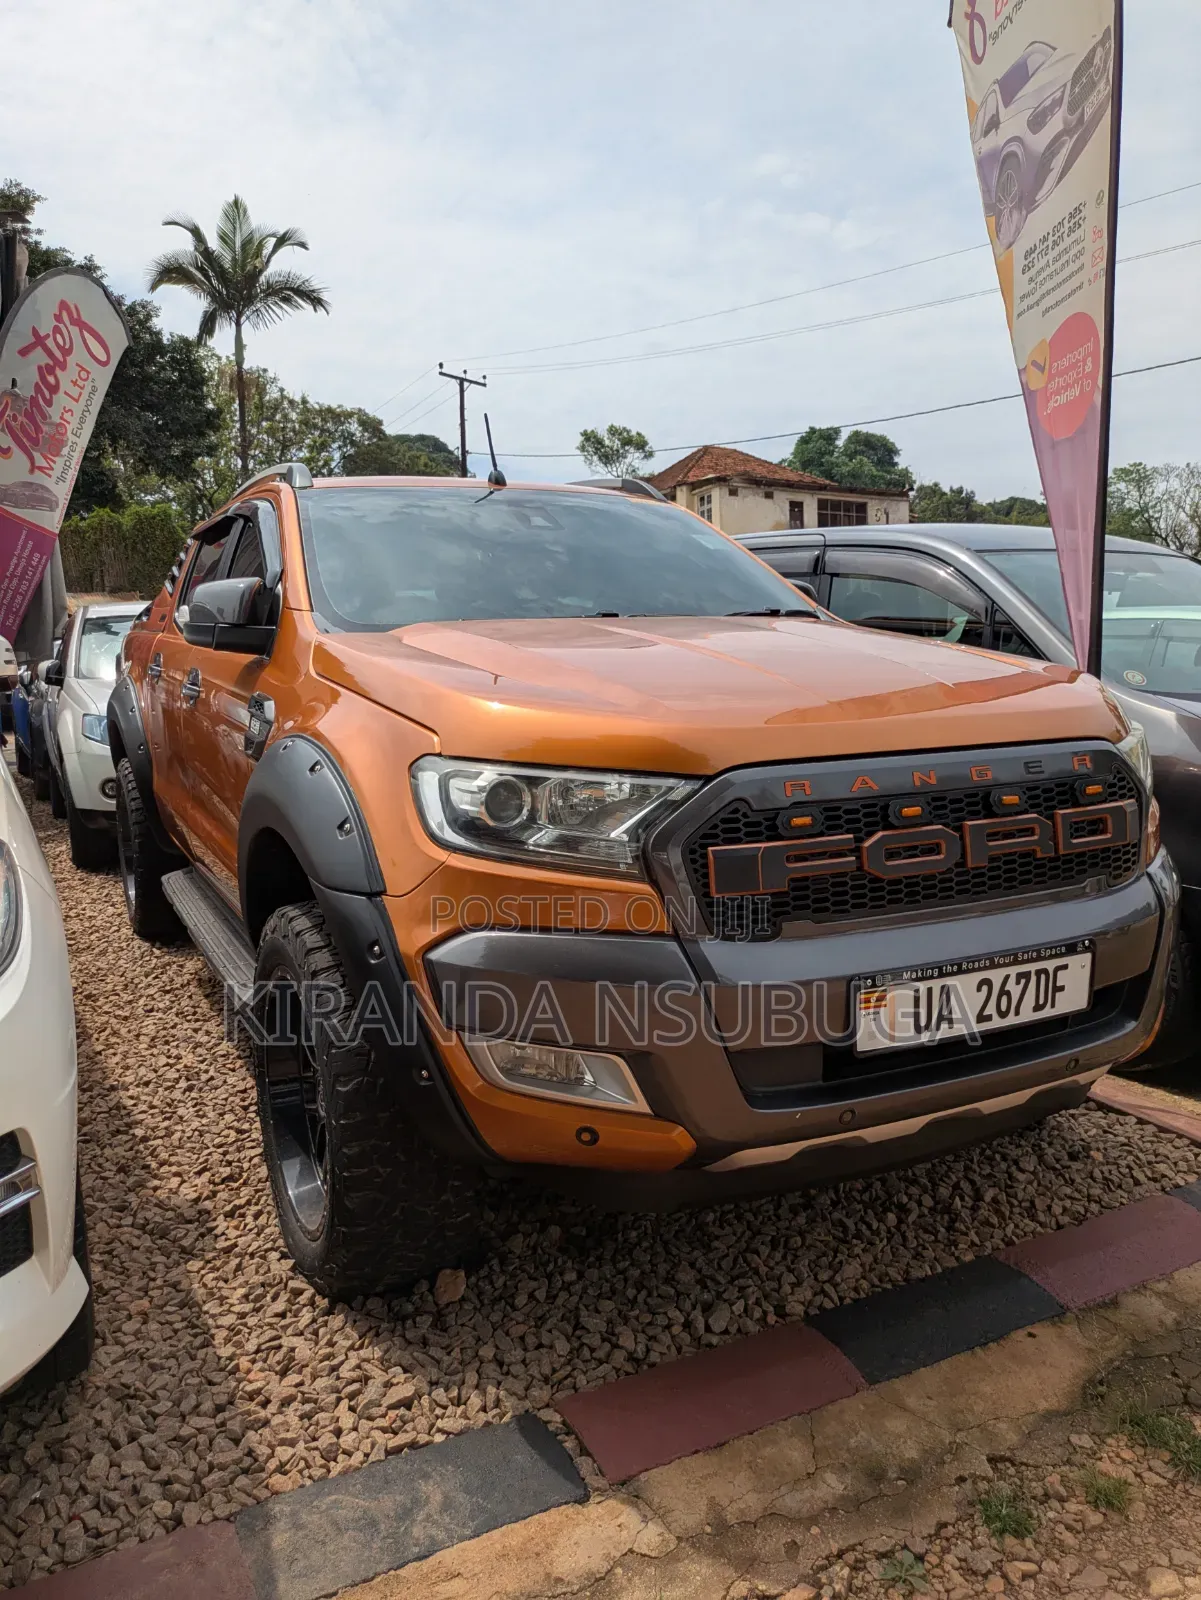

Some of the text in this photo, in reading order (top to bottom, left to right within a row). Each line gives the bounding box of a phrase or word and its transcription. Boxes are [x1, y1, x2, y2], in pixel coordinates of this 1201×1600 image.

[0, 298, 111, 475] Timotez
[35, 362, 92, 479] Motors Ltd
[55, 377, 97, 487] "Inspires Everyone"
[12, 593, 24, 612] +256
[19, 580, 29, 595] 703
[25, 567, 35, 581] 141
[31, 552, 41, 568] 449
[24, 540, 34, 559] House
[784, 754, 1093, 798] RANGER
[708, 799, 1139, 897] FORD
[902, 967, 939, 982] Making
[942, 963, 958, 974] the
[961, 958, 990, 971] Roads
[994, 954, 1014, 966] Your
[1017, 950, 1037, 961] Safe
[1040, 945, 1066, 959] Space
[913, 963, 1070, 1036] UA 267DF
